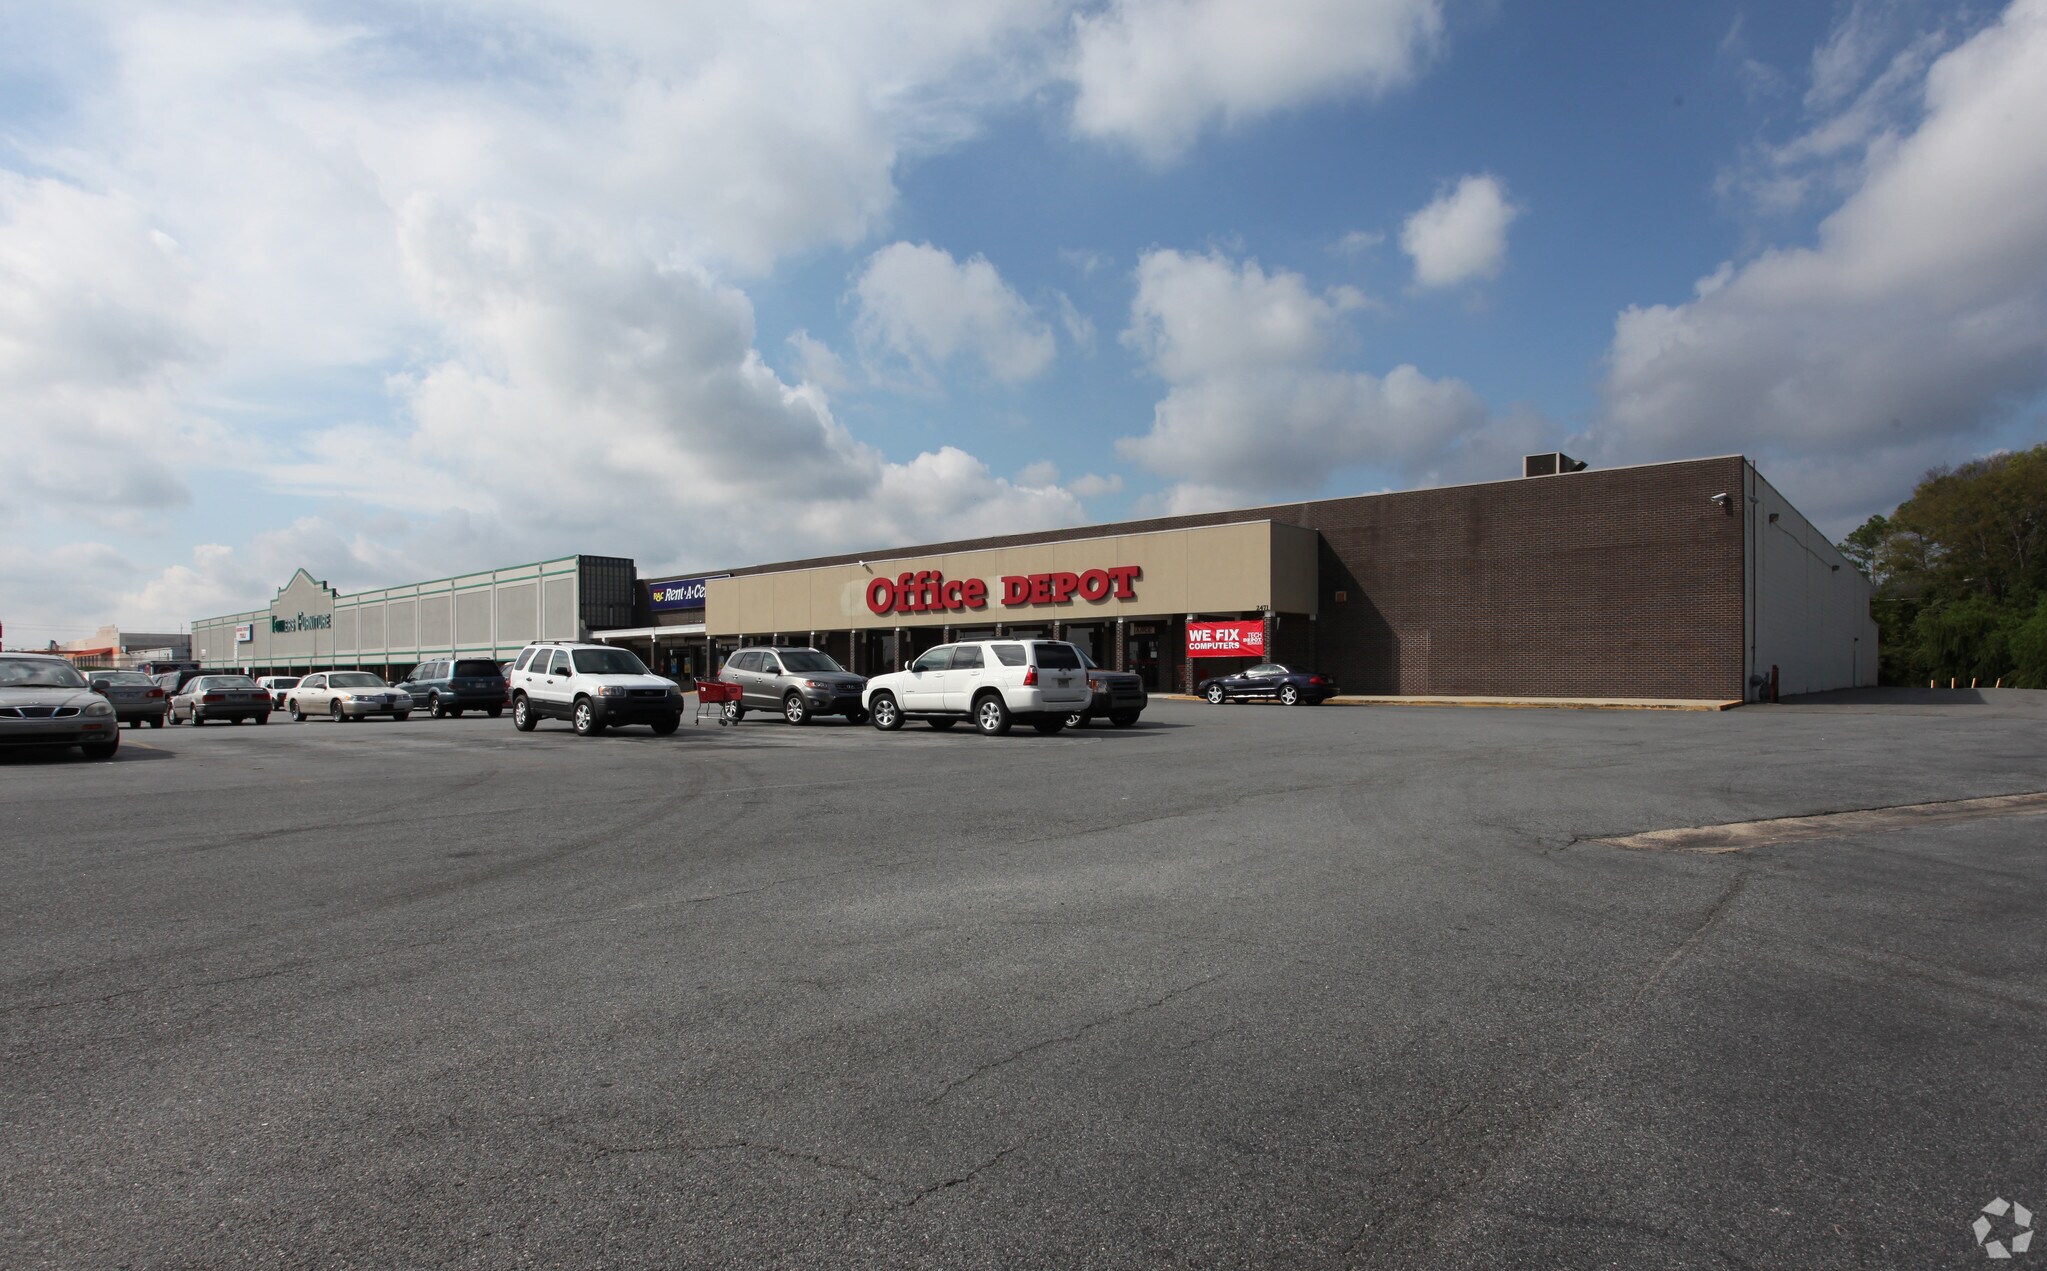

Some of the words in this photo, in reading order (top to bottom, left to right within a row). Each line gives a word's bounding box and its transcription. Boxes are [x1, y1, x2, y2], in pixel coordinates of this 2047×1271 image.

[866, 570, 987, 614] Office
[1001, 566, 1140, 605] DEPOT
[298, 611, 331, 631] FURNITURE
[1189, 630, 1211, 641] WE
[1216, 629, 1239, 641] FIX
[1189, 642, 1240, 650] COMPUTERS
